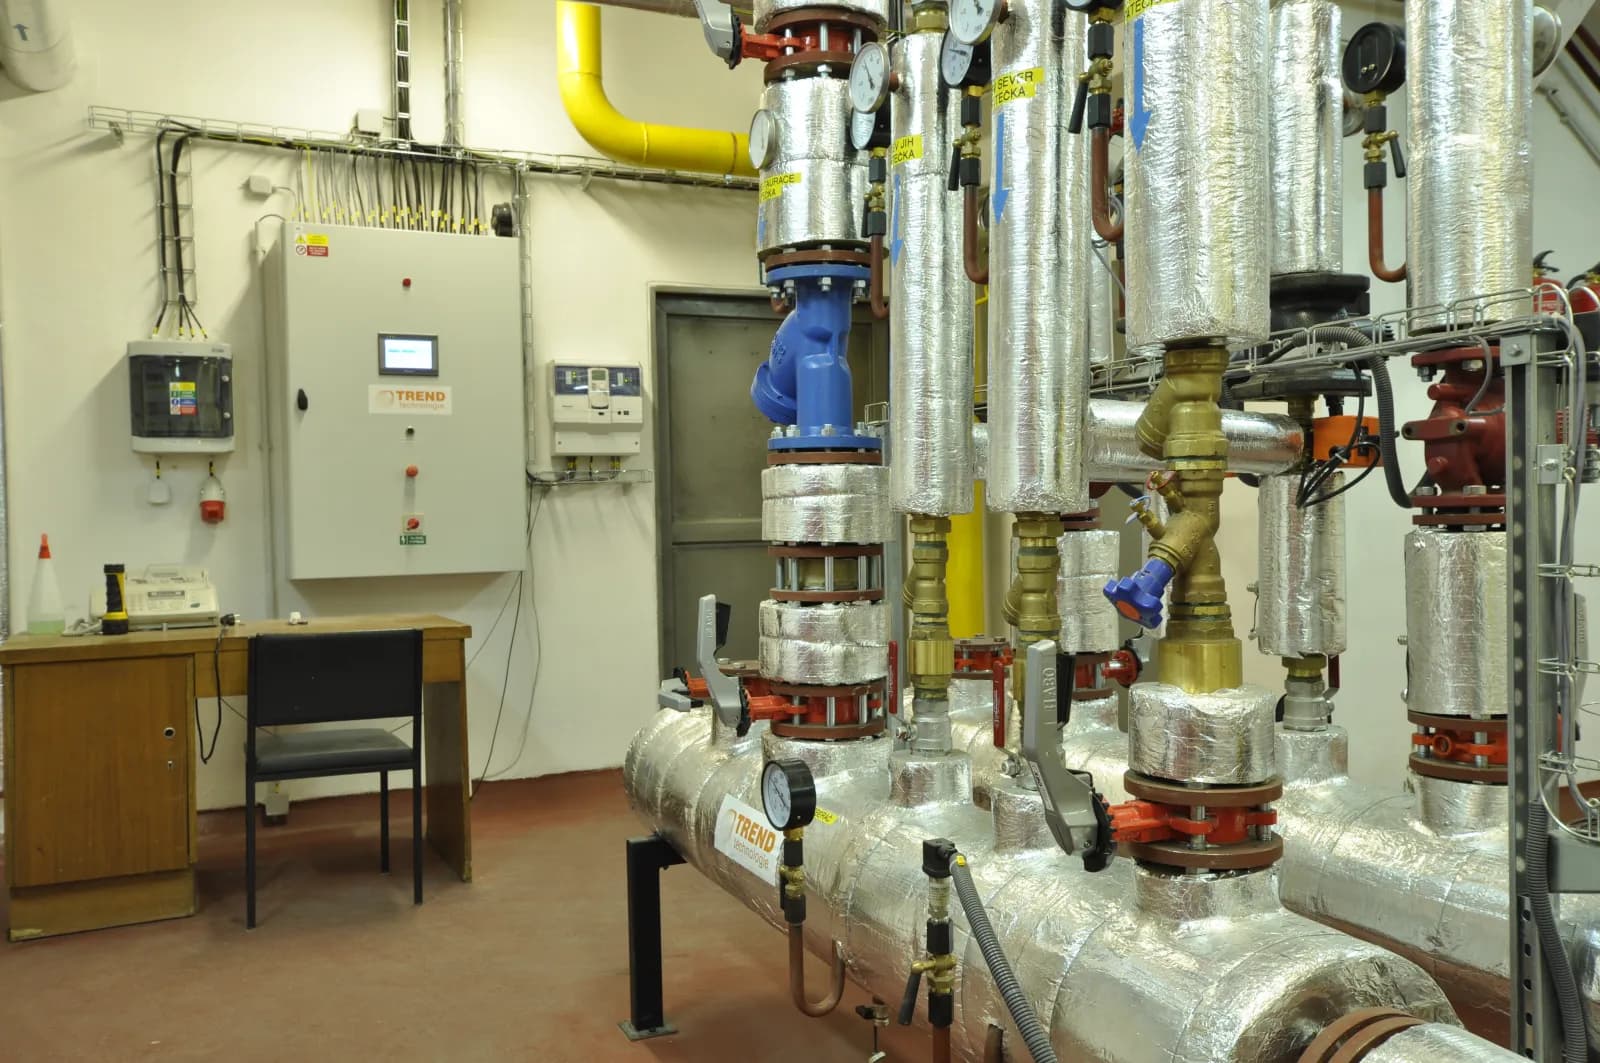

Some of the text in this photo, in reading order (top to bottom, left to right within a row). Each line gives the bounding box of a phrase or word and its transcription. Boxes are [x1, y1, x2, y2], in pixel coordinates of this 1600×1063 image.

[998, 71, 1033, 90] SEVER
[995, 86, 1026, 105] TEČKA
[901, 137, 914, 149] JIH
[893, 149, 915, 164] EČKA
[396, 390, 446, 402] TREND
[735, 813, 777, 854] TREND
[733, 839, 770, 870] technologie
